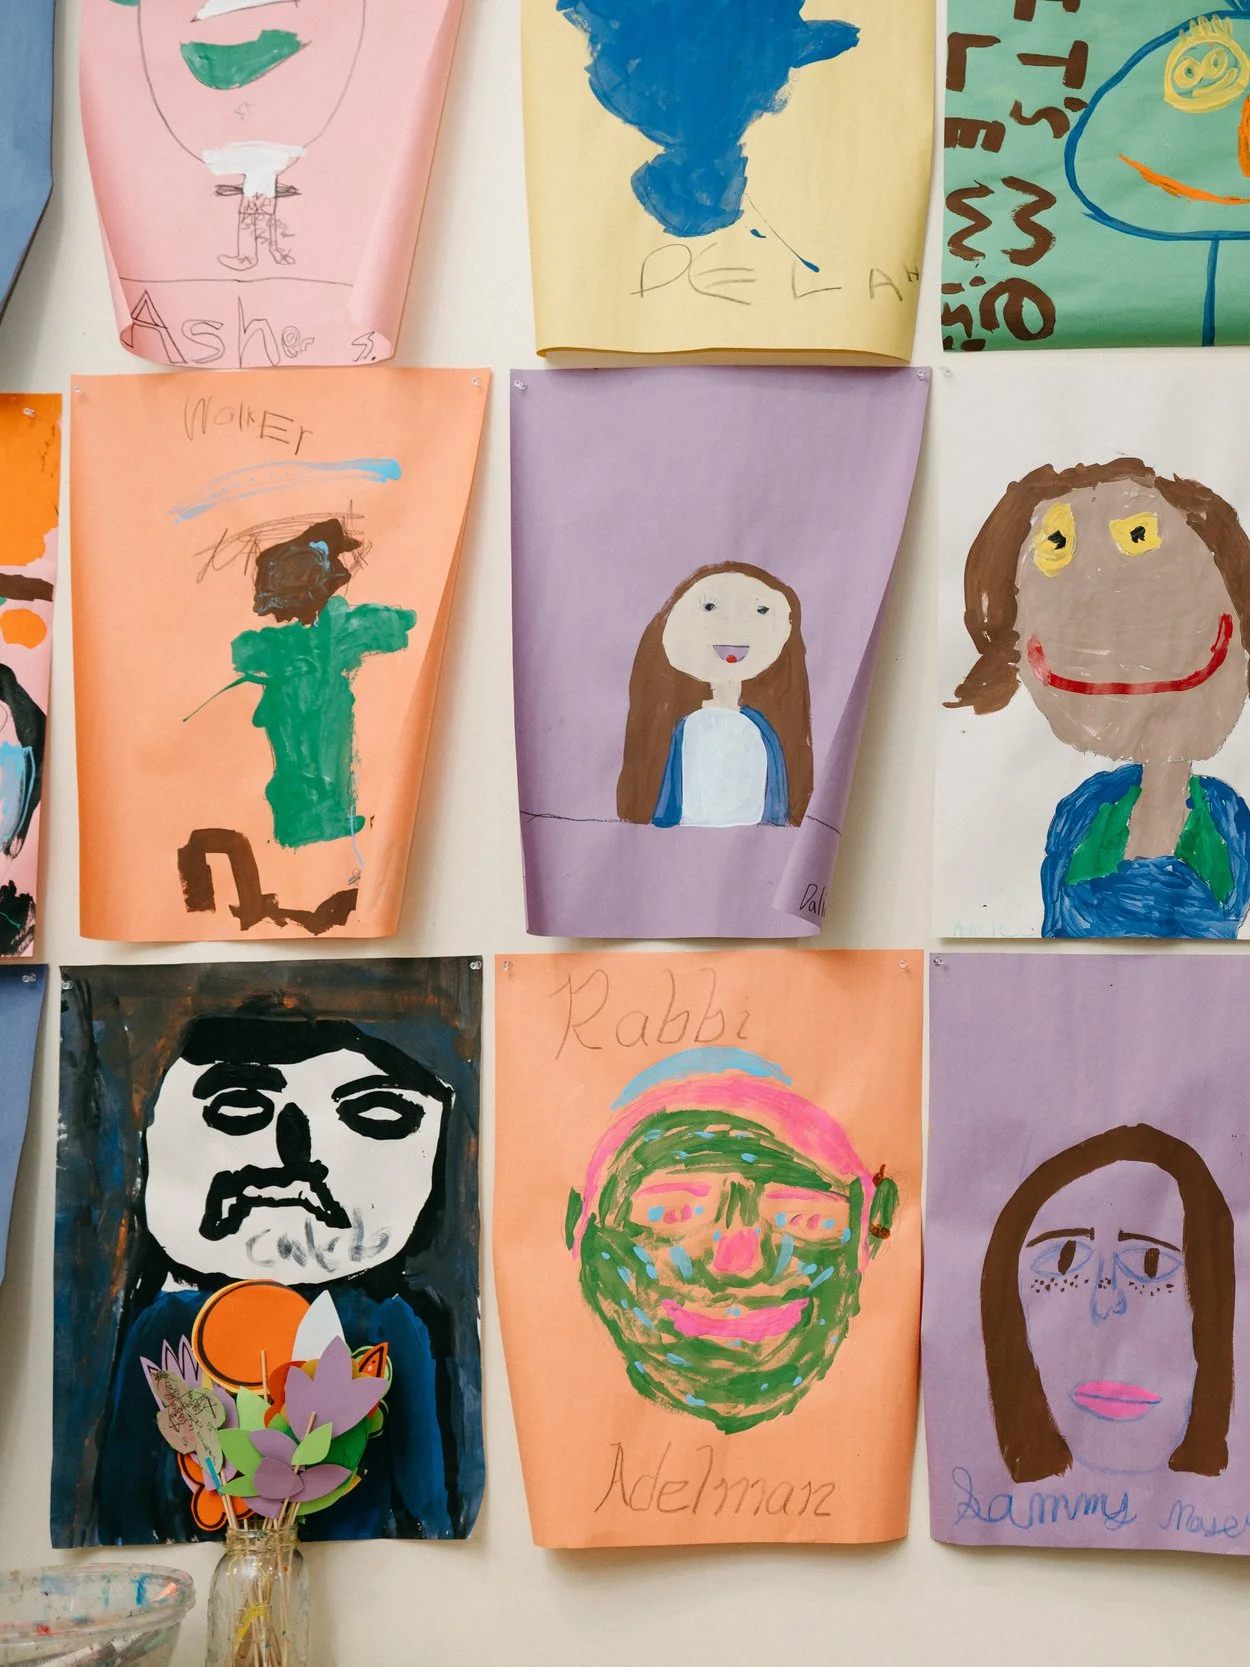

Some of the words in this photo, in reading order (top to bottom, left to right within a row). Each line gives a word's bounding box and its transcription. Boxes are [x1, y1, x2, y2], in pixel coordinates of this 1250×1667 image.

[119, 289, 315, 368] Asher
[542, 968, 750, 1060] Rabbi
[594, 1441, 836, 1517] Adelman
[952, 1466, 1137, 1531] Sammy
